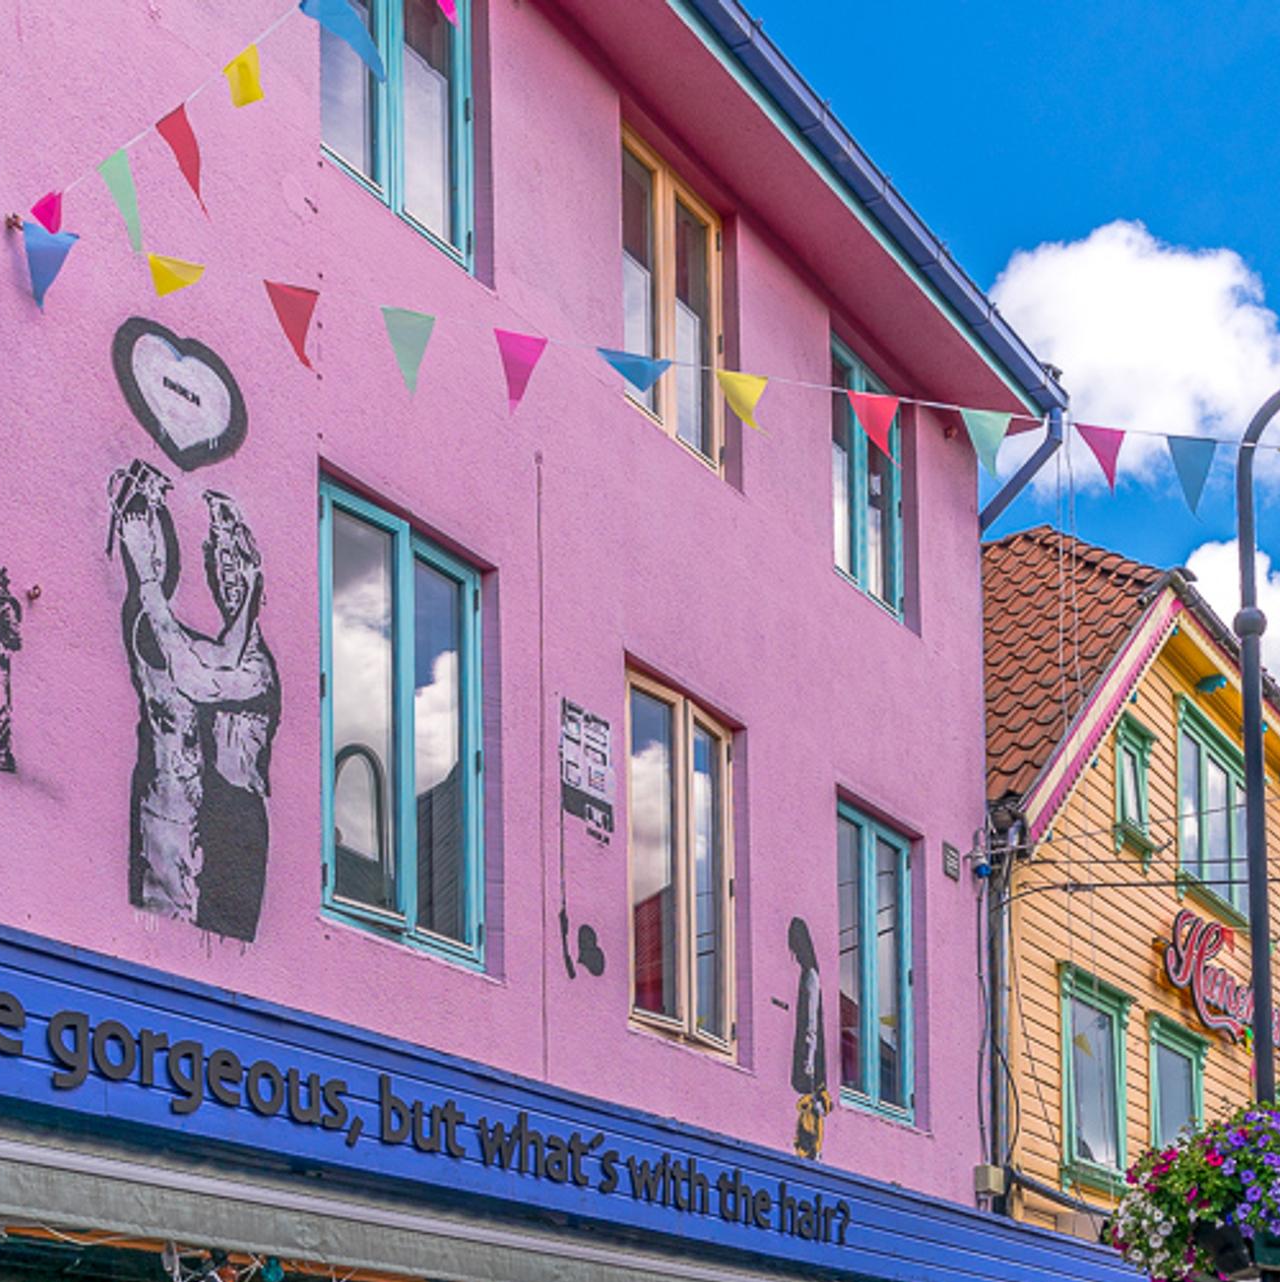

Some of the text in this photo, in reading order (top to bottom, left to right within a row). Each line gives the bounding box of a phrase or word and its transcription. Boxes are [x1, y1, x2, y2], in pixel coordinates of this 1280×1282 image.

[47, 1010, 362, 1146] gorgeous,
[379, 1073, 466, 1157] but
[627, 1152, 709, 1214] with
[718, 1169, 771, 1228] the
[778, 1181, 851, 1245] hair?
